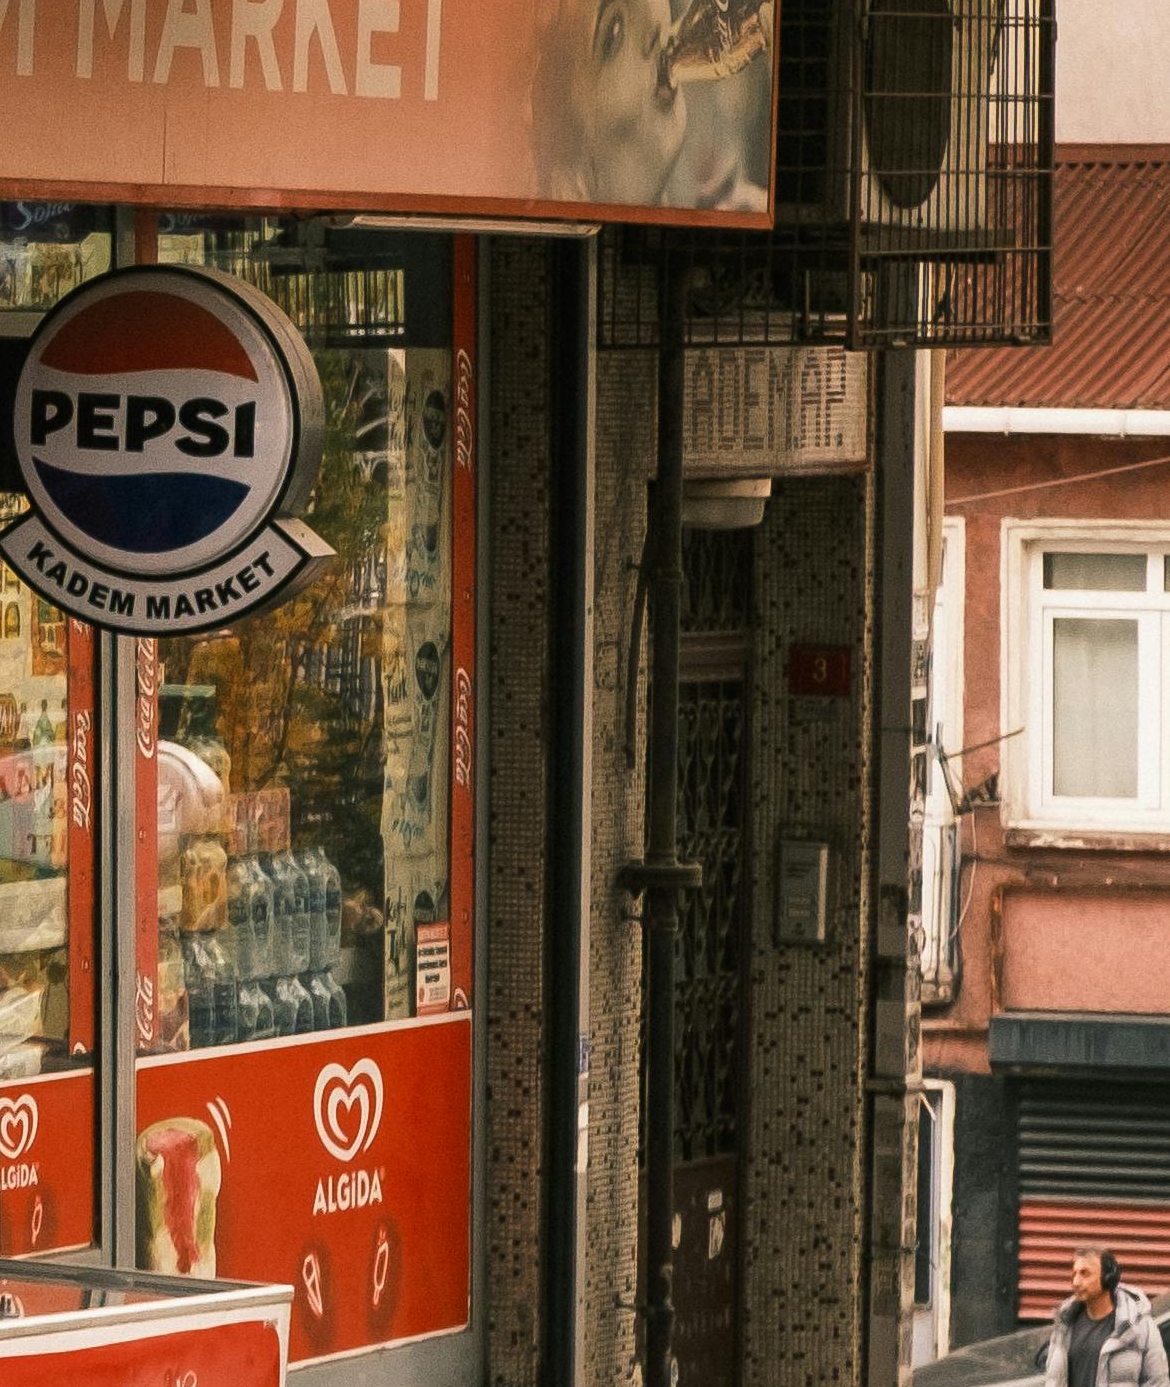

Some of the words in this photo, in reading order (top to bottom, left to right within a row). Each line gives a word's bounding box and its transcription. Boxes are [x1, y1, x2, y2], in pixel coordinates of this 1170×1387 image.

[31, 389, 256, 460] PEPSI
[26, 541, 135, 618] KADEM
[145, 551, 277, 622] MARKET
